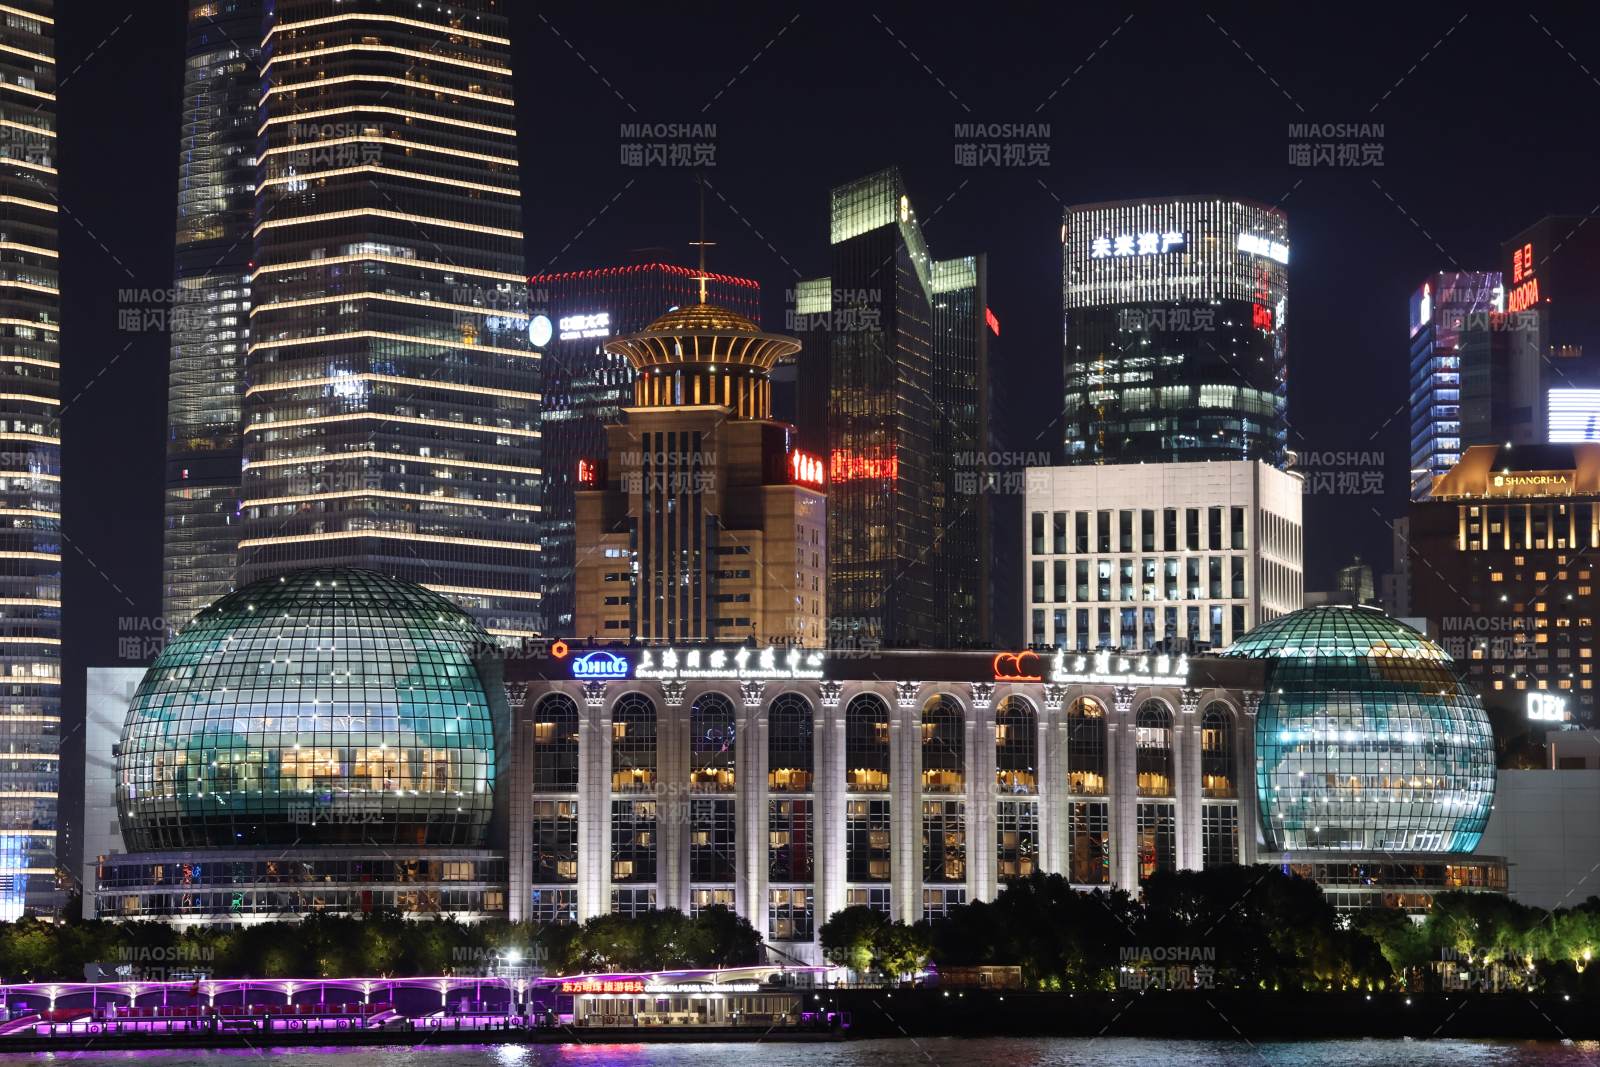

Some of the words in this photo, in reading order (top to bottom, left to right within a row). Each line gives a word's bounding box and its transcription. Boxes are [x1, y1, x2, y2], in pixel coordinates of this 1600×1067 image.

[1508, 278, 1539, 313] AURORA
[1505, 475, 1567, 485] SHANGRI-LA
[636, 669, 677, 679] Shanghai
[680, 669, 737, 678] International
